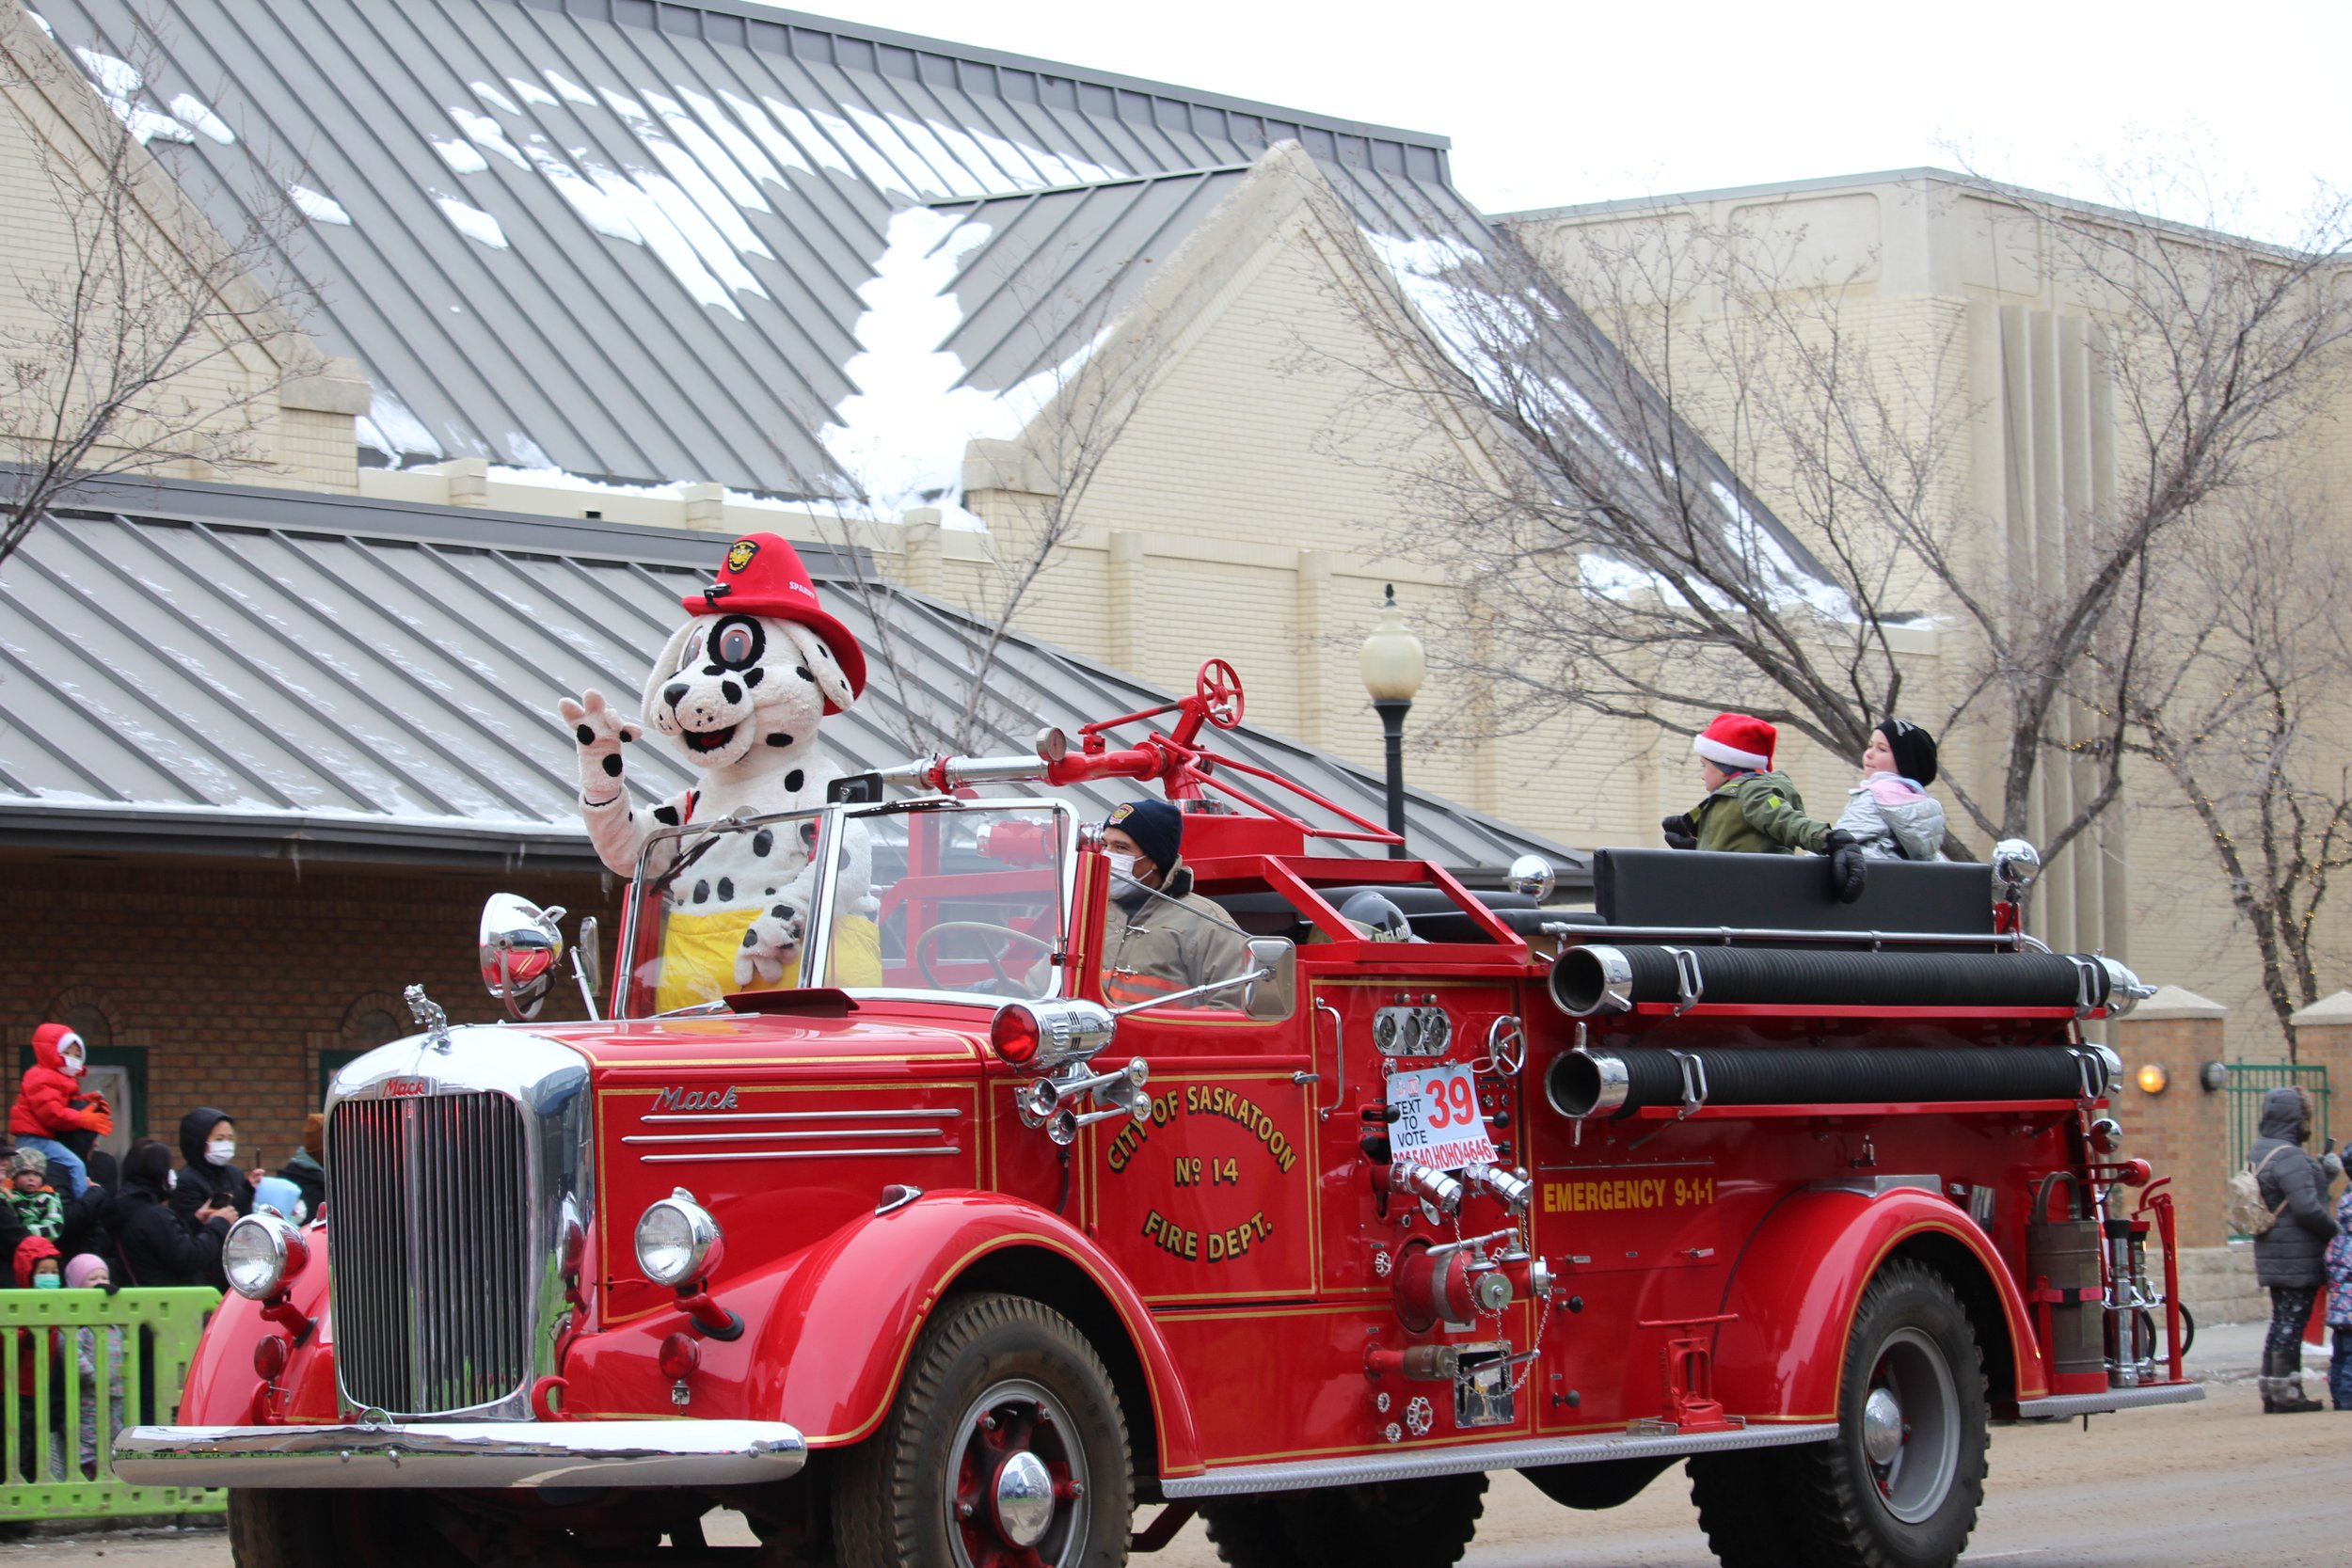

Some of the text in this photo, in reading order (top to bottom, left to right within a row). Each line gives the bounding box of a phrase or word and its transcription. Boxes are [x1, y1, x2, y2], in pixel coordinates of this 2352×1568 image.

[382, 1077, 425, 1099] Mack
[651, 1085, 739, 1111] Mack
[1395, 1099, 1422, 1116] TEXT
[1424, 1076, 1475, 1130] 39
[1107, 1085, 1298, 1173] CITY OF SASKATOON
[1403, 1116, 1418, 1131] TO
[1397, 1131, 1428, 1147] VOTE
[1213, 1158, 1239, 1185] 14
[1543, 1178, 1713, 1212] EMERGENCY 9-1-1
[1142, 1210, 1273, 1261] FIRE DEPT.
